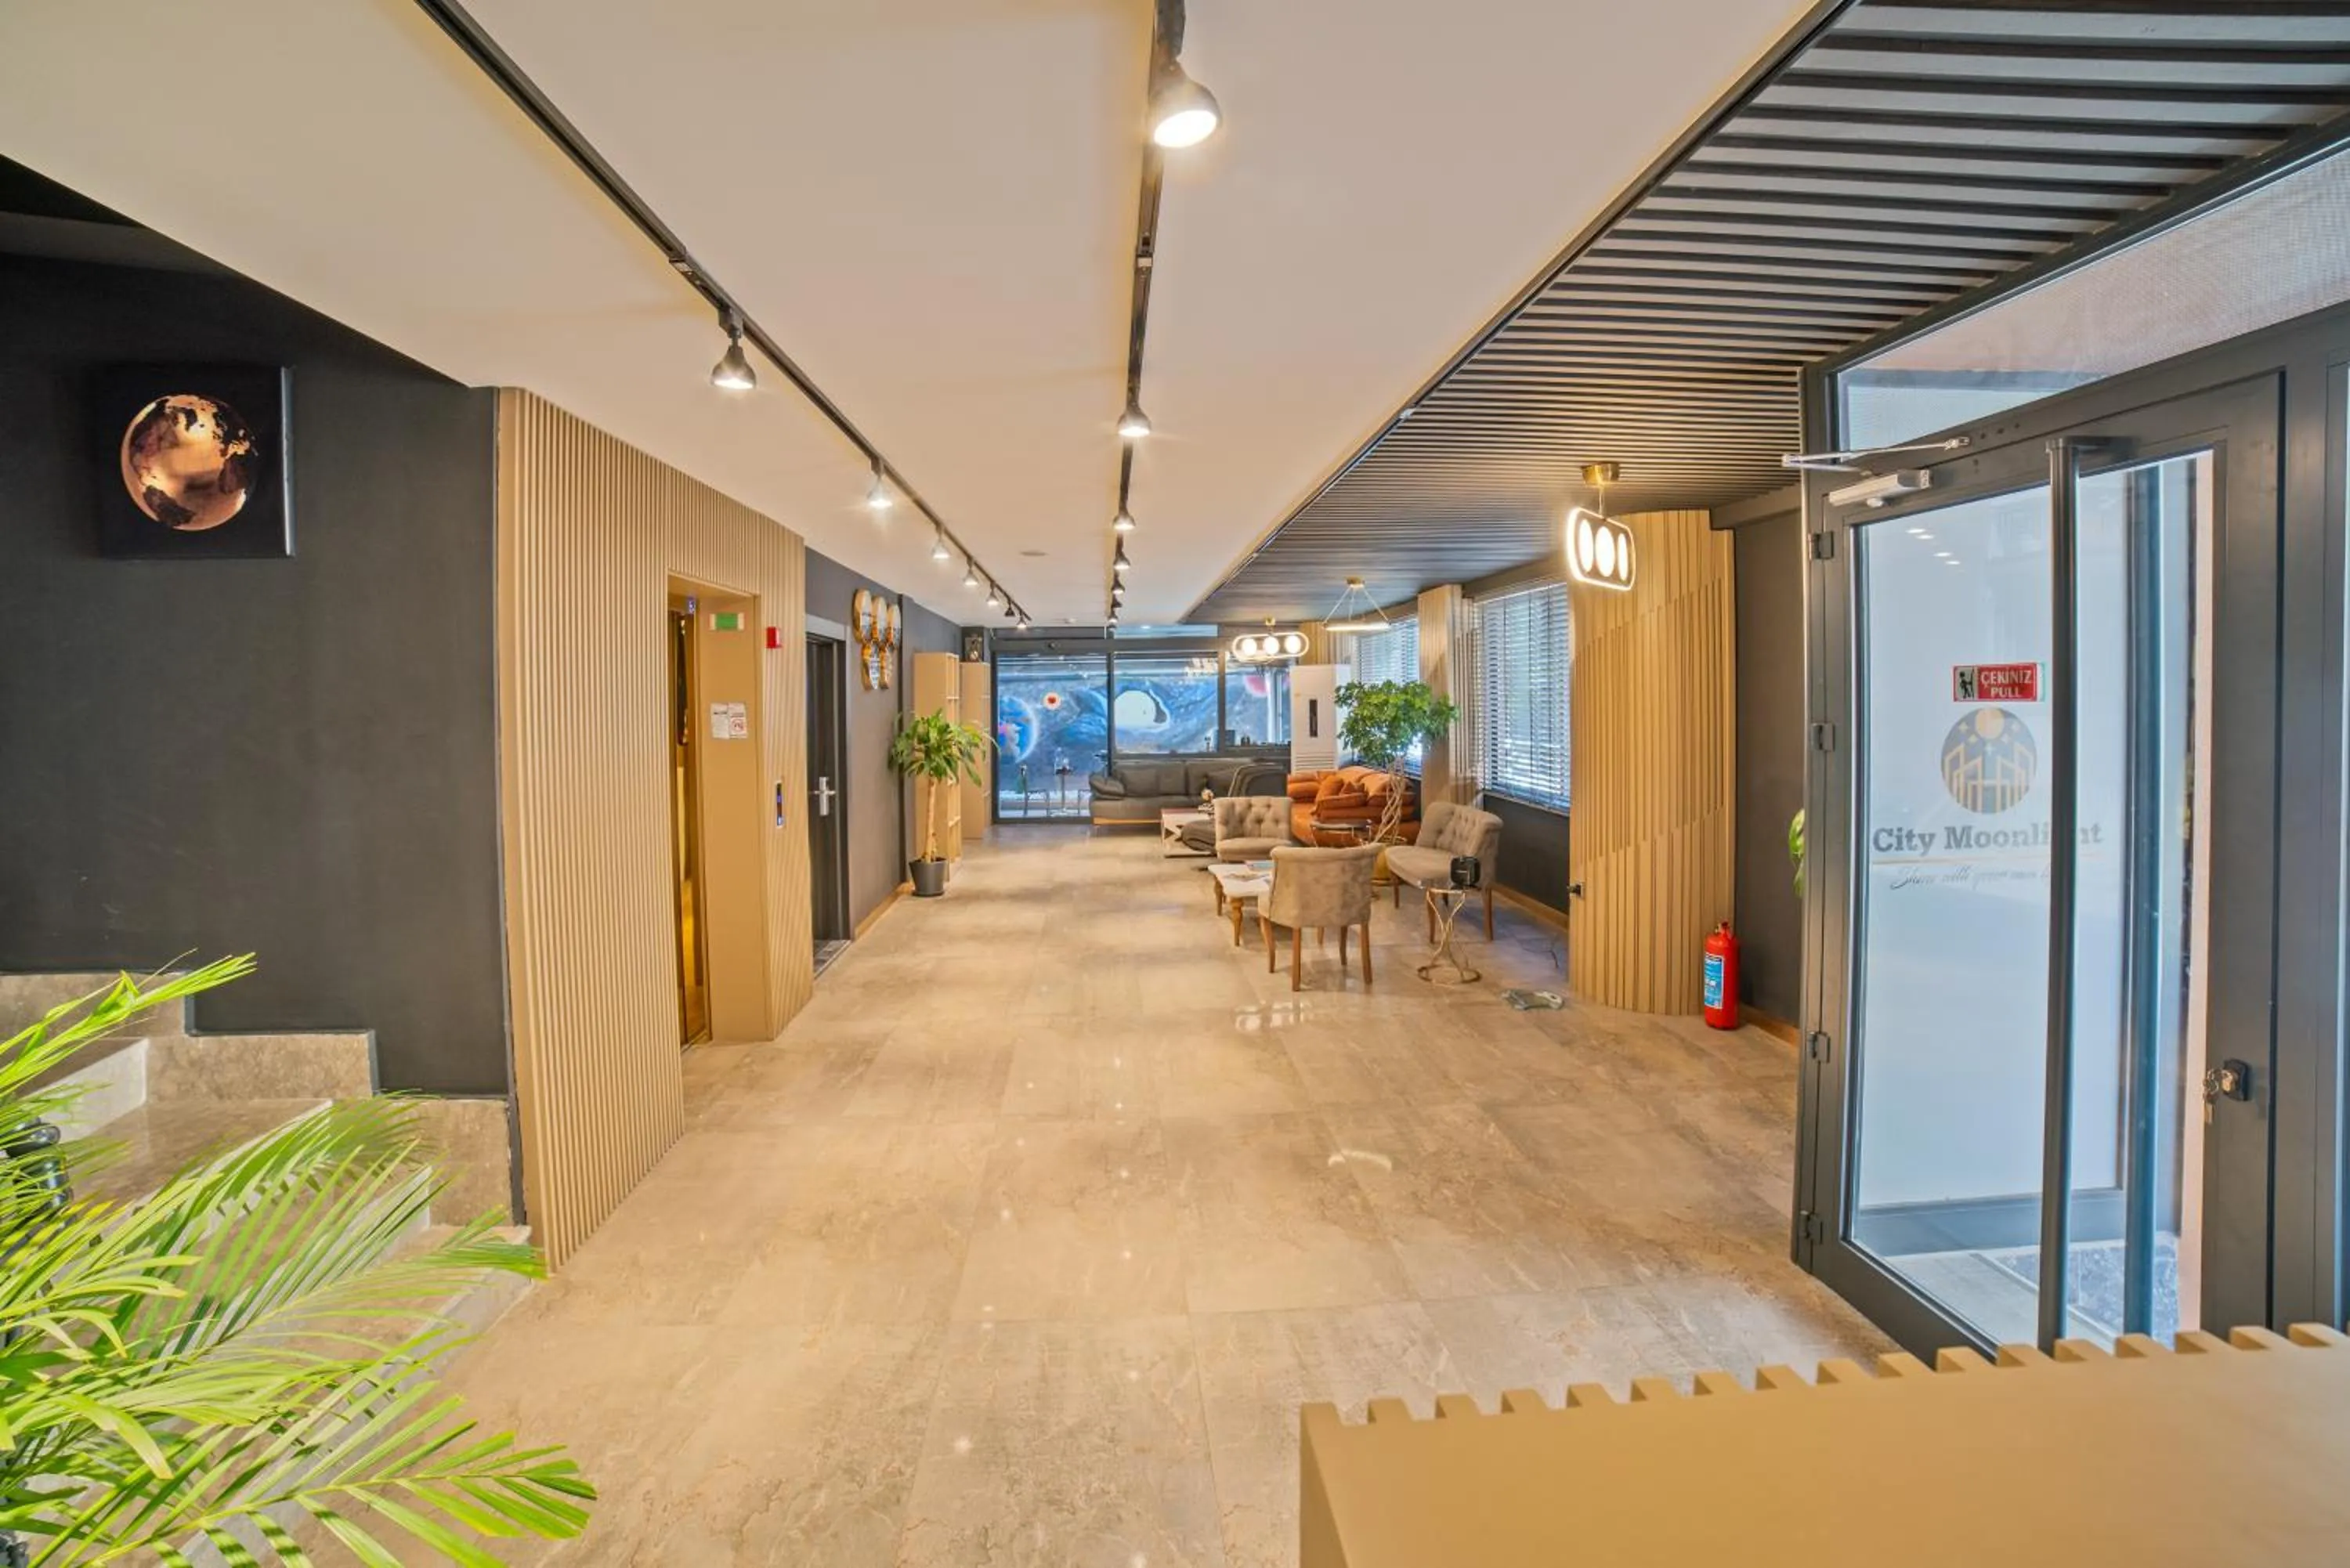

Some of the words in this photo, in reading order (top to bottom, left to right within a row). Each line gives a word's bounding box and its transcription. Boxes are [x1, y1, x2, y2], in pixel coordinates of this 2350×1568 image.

[1990, 686, 2022, 698] PULL
[1873, 827, 1936, 855] City
[1944, 822, 2105, 850] Moonlit
